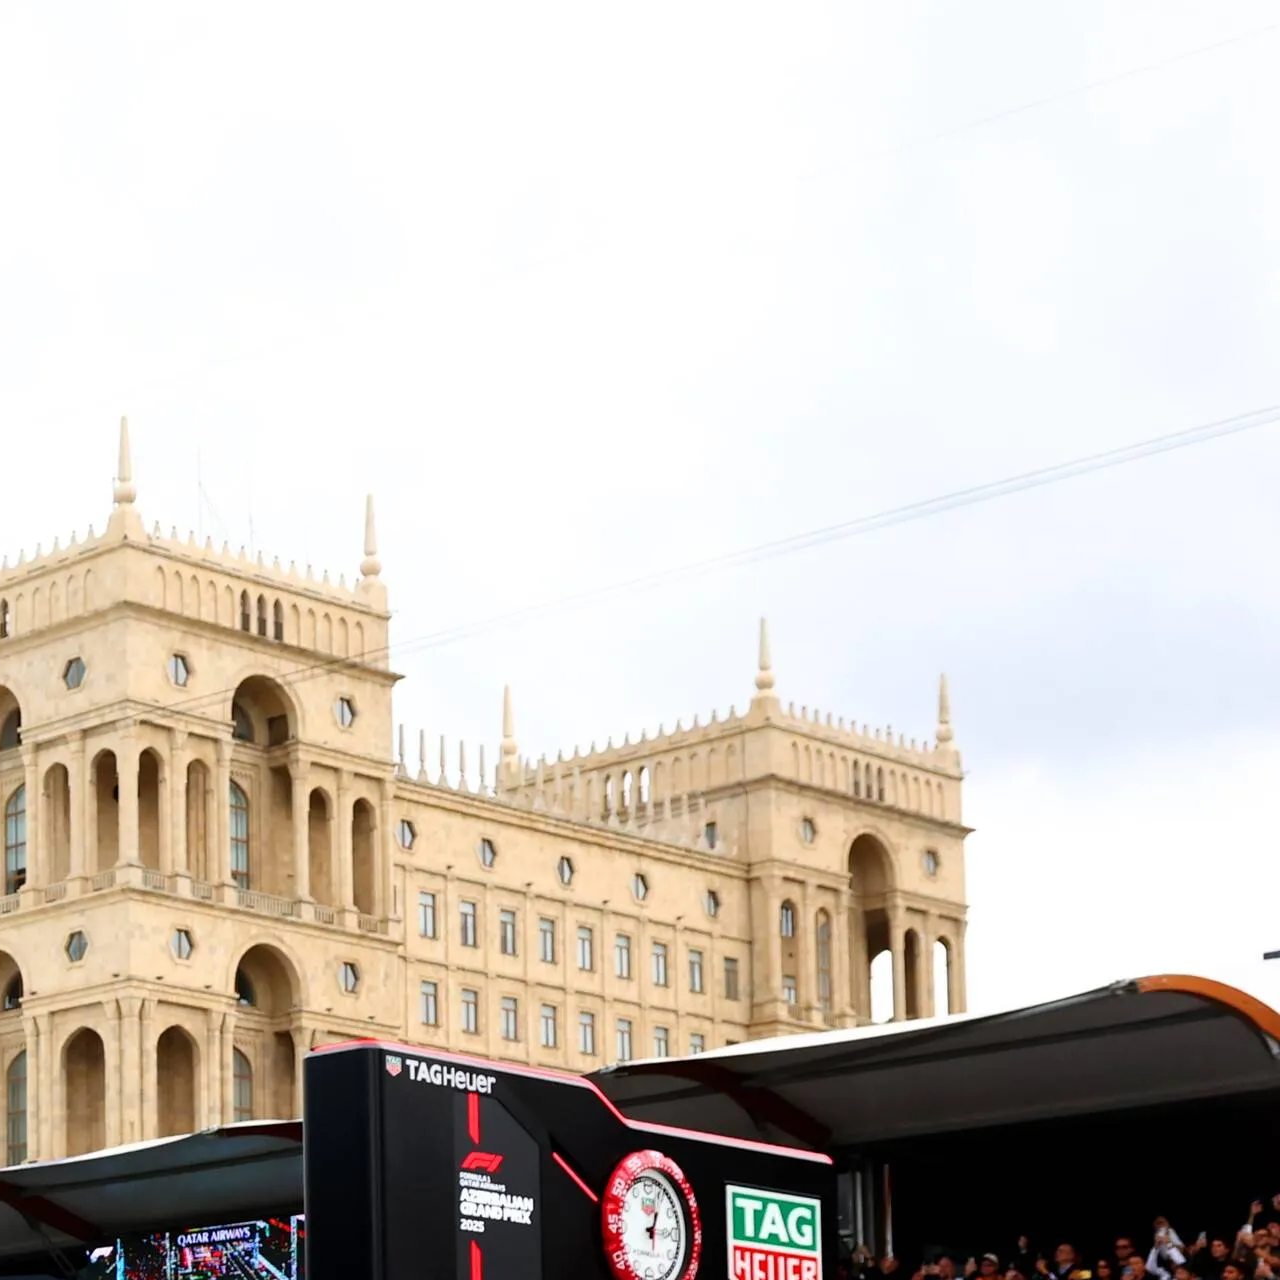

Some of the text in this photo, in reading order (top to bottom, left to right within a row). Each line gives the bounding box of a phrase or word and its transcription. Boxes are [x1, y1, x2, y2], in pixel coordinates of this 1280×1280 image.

[611, 1177, 625, 1197] 50
[460, 1187, 534, 1212] AZERBAIJAN
[460, 1201, 532, 1225] GRAND PRIX
[736, 1198, 814, 1247] TAG
[460, 1218, 485, 1232] 2025
[607, 1214, 619, 1234] 45
[177, 1226, 251, 1247] QATAR AIRWAYS
